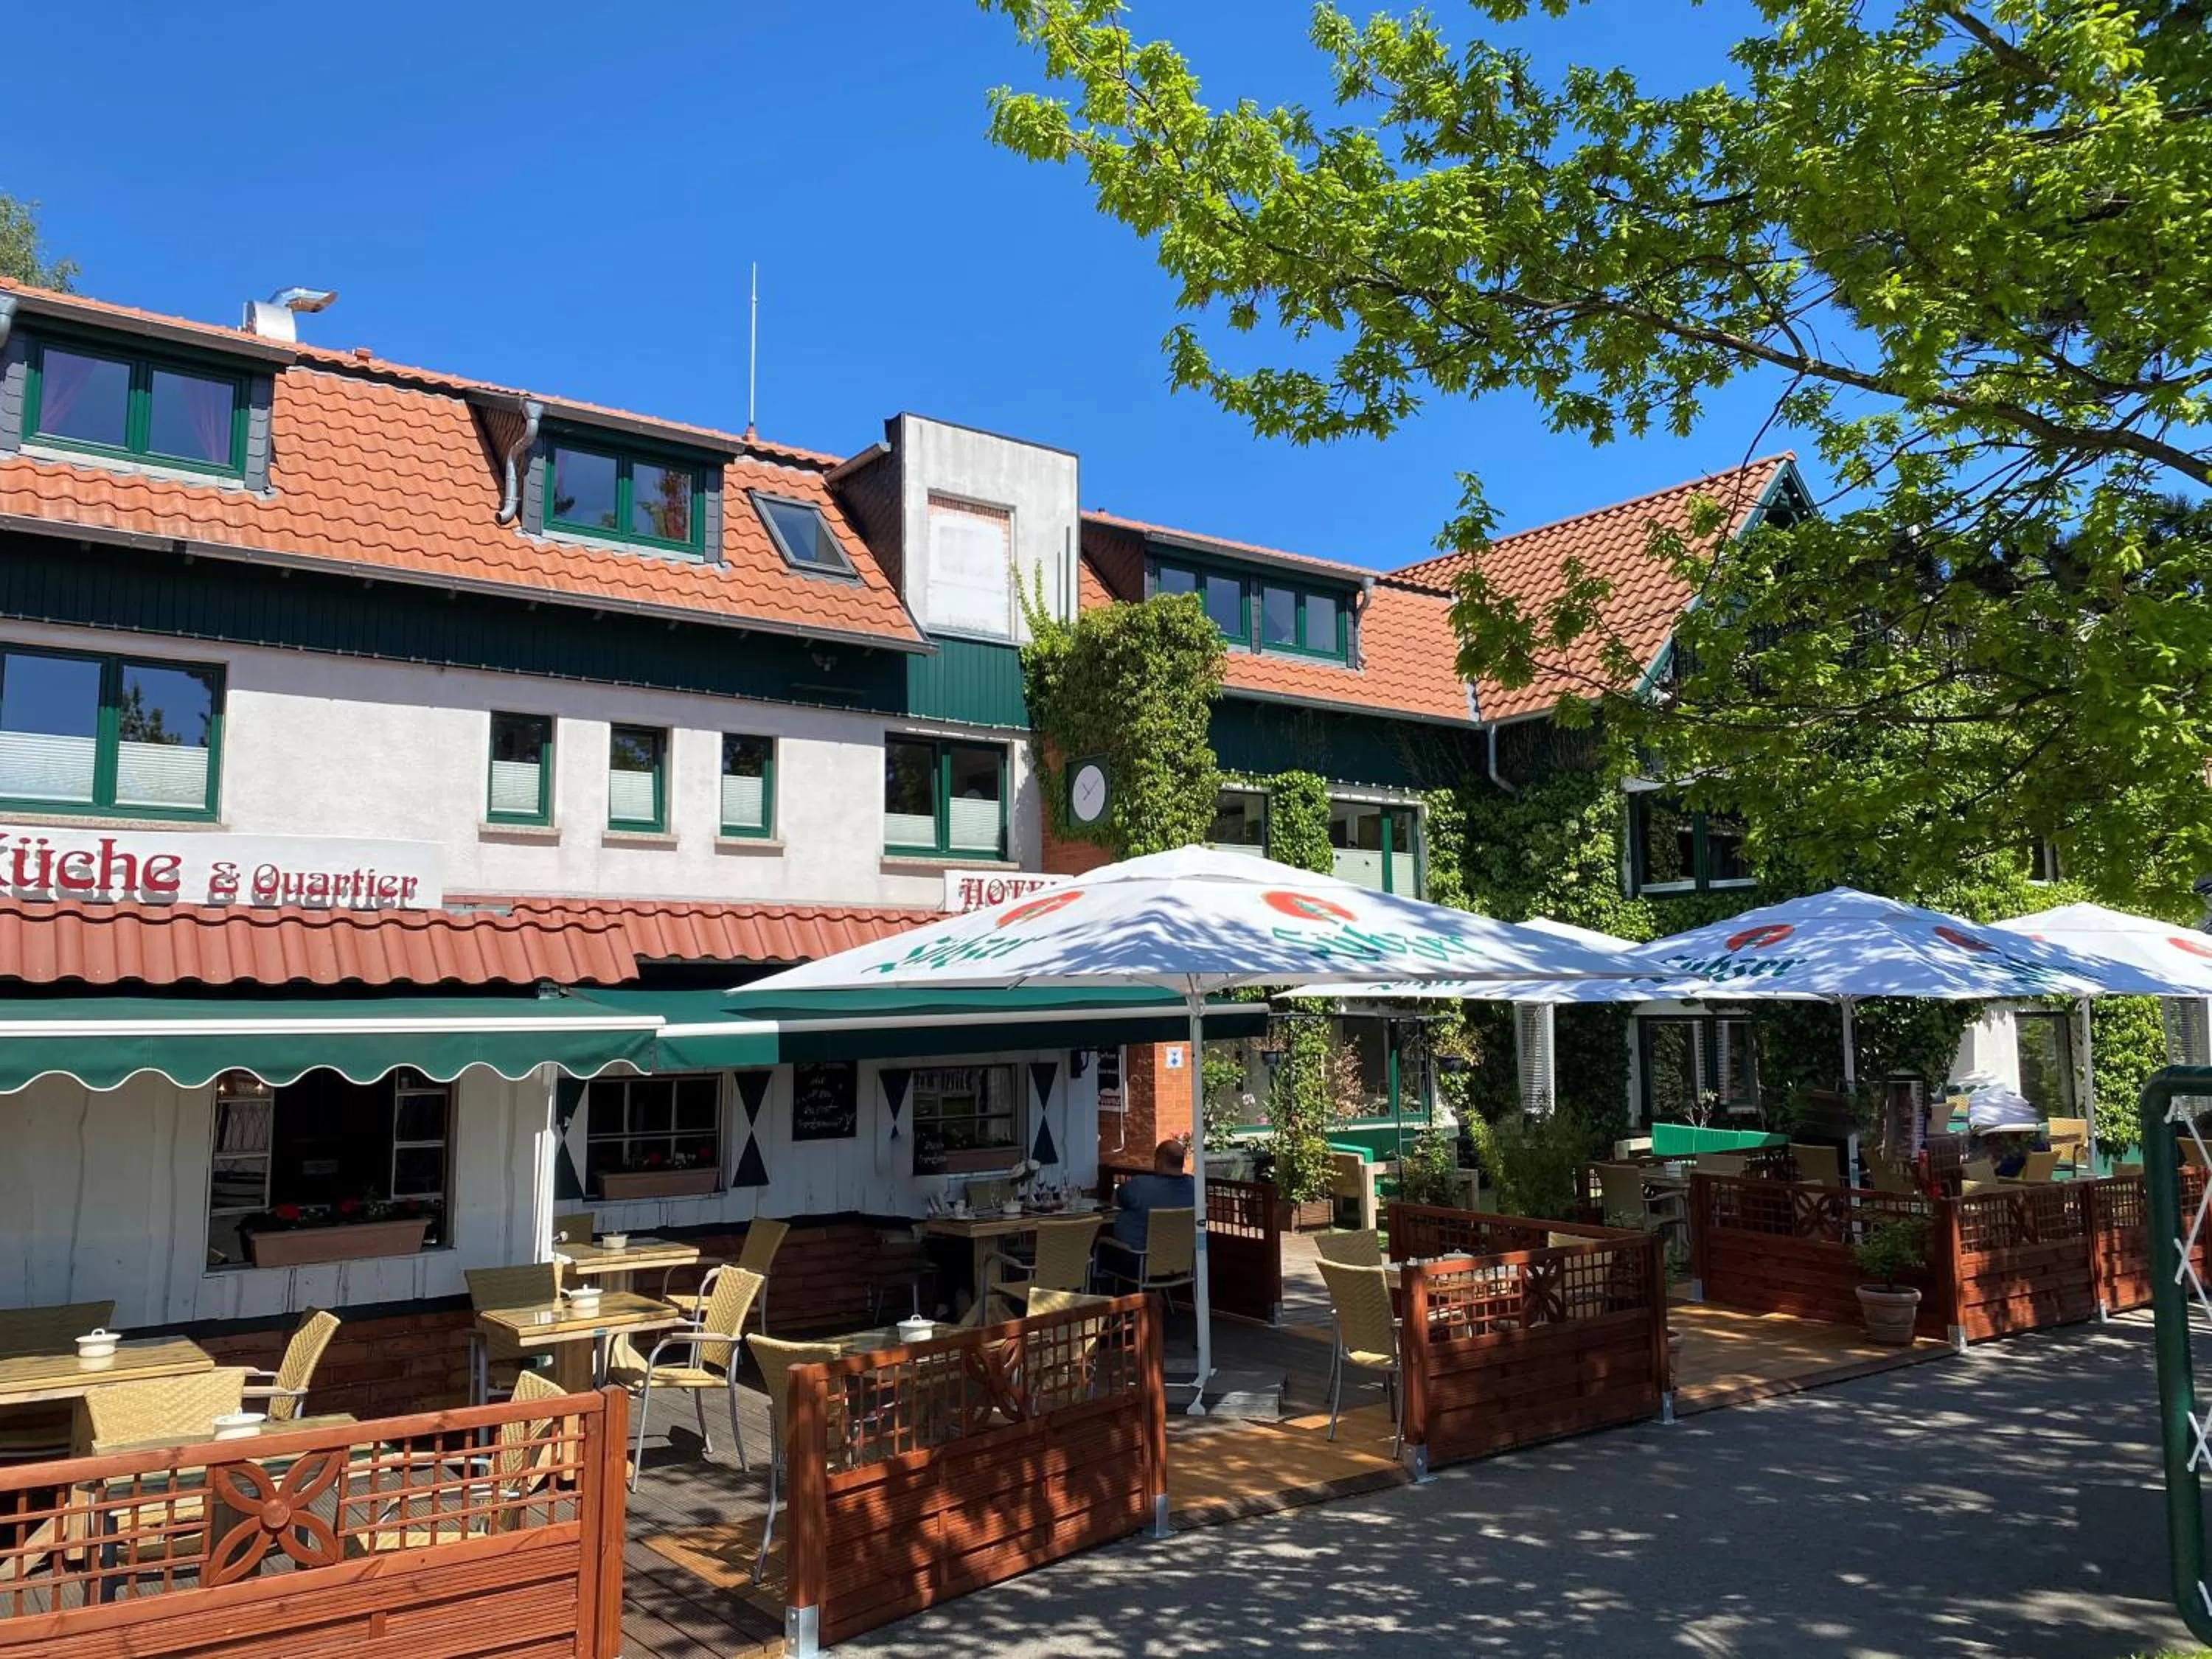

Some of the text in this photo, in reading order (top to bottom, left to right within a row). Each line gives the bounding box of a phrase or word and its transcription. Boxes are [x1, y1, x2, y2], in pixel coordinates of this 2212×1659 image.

[209, 862, 241, 894] &
[254, 863, 418, 900] Quartier
[961, 877, 1057, 905] HOT
